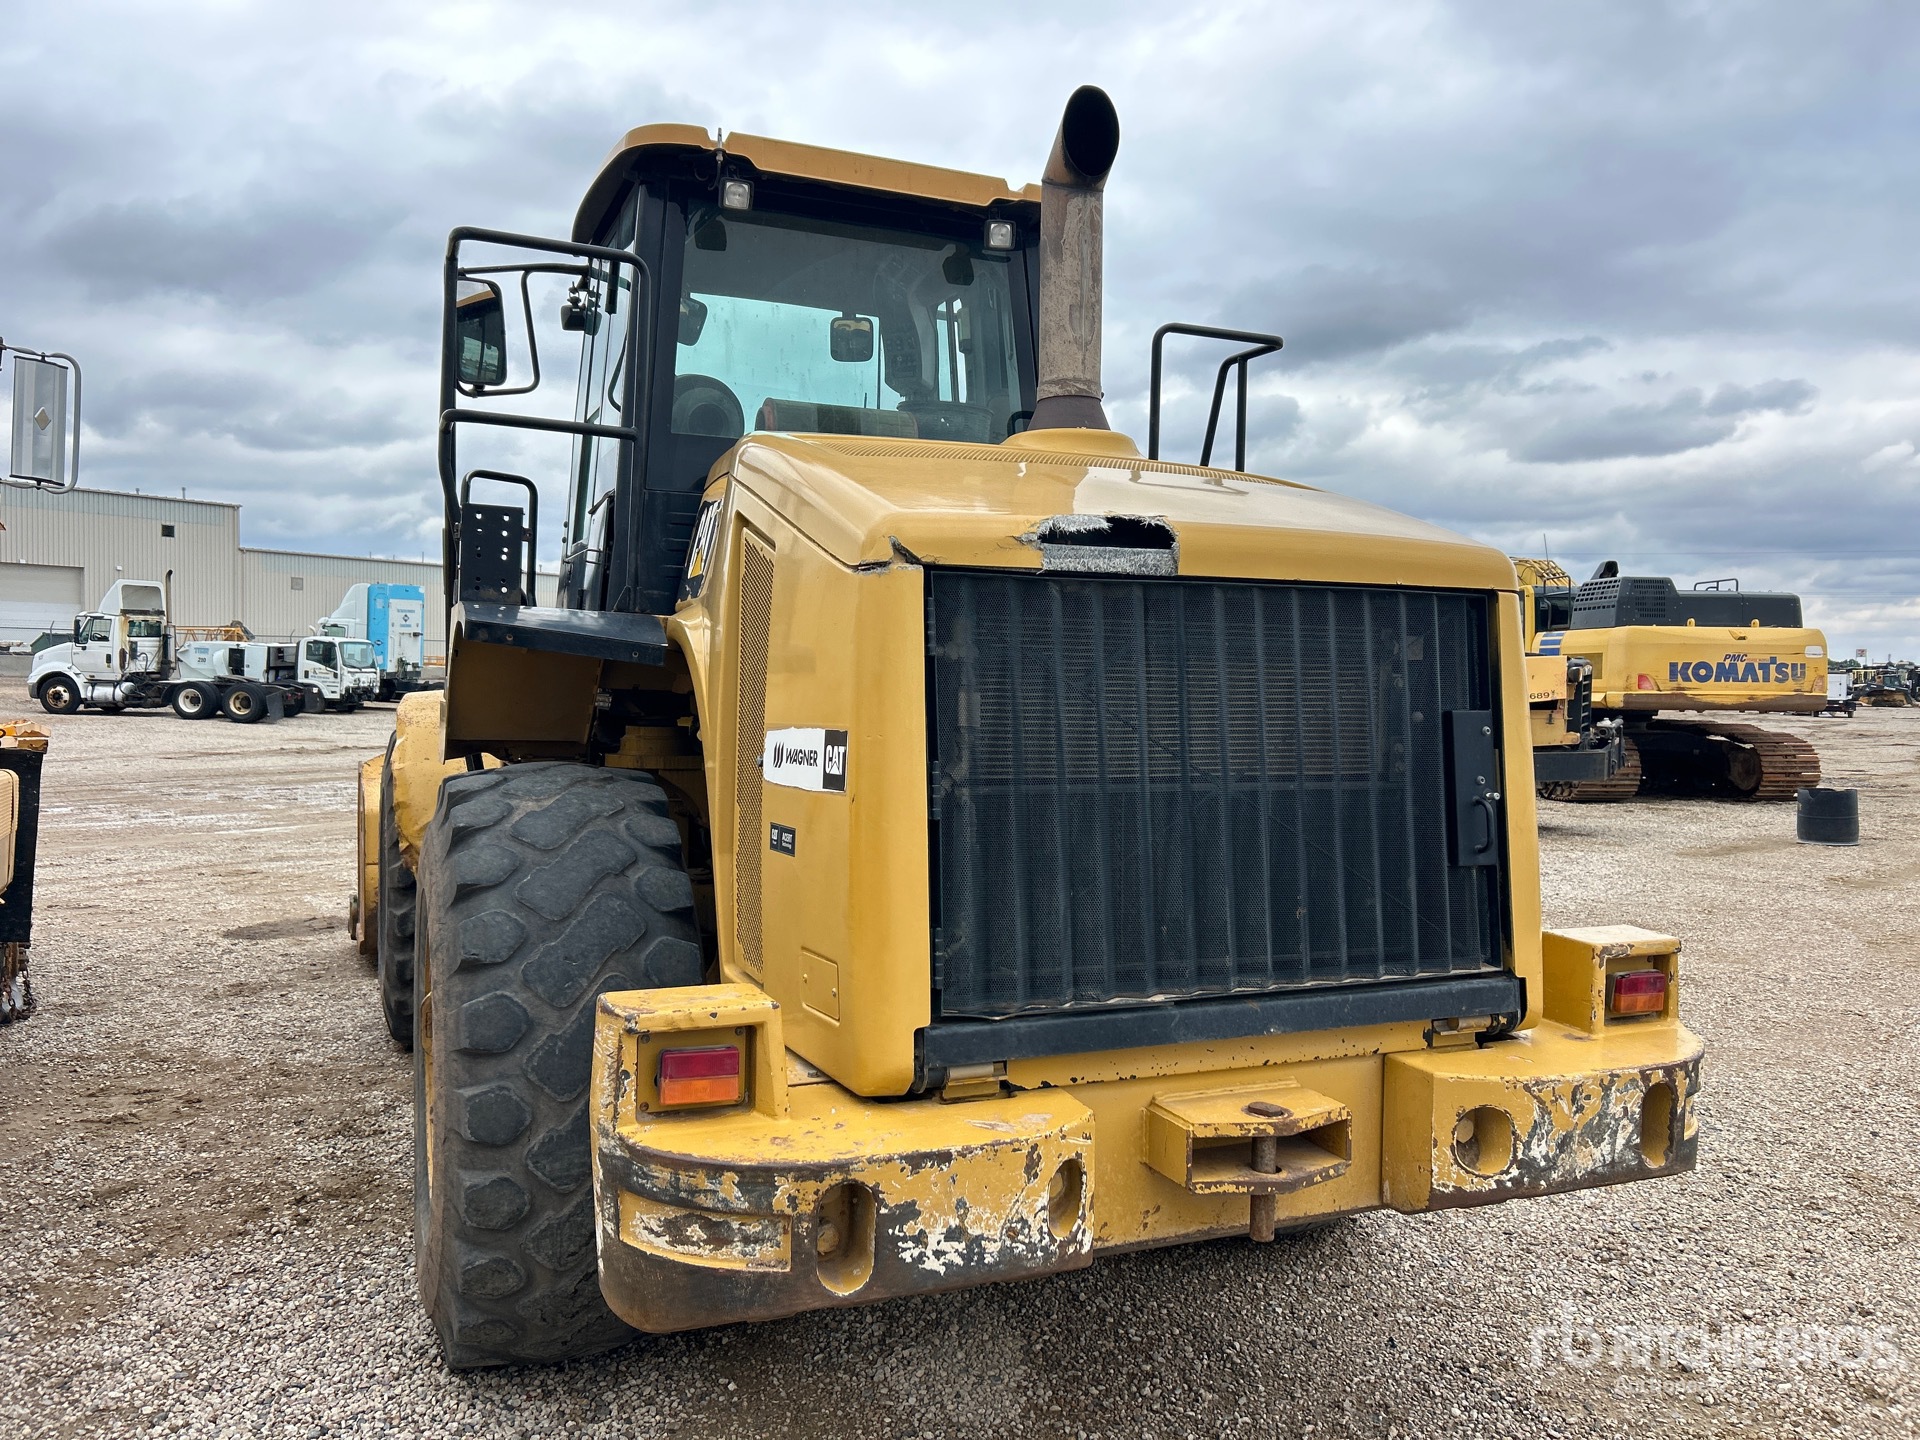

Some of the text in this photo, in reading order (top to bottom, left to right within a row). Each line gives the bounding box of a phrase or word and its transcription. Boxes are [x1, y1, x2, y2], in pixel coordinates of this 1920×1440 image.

[1723, 653, 1748, 663] PMC
[1669, 656, 1807, 684] KOMATSU
[1529, 691, 1550, 700] 689
[785, 744, 846, 776] WAGNER CAT
